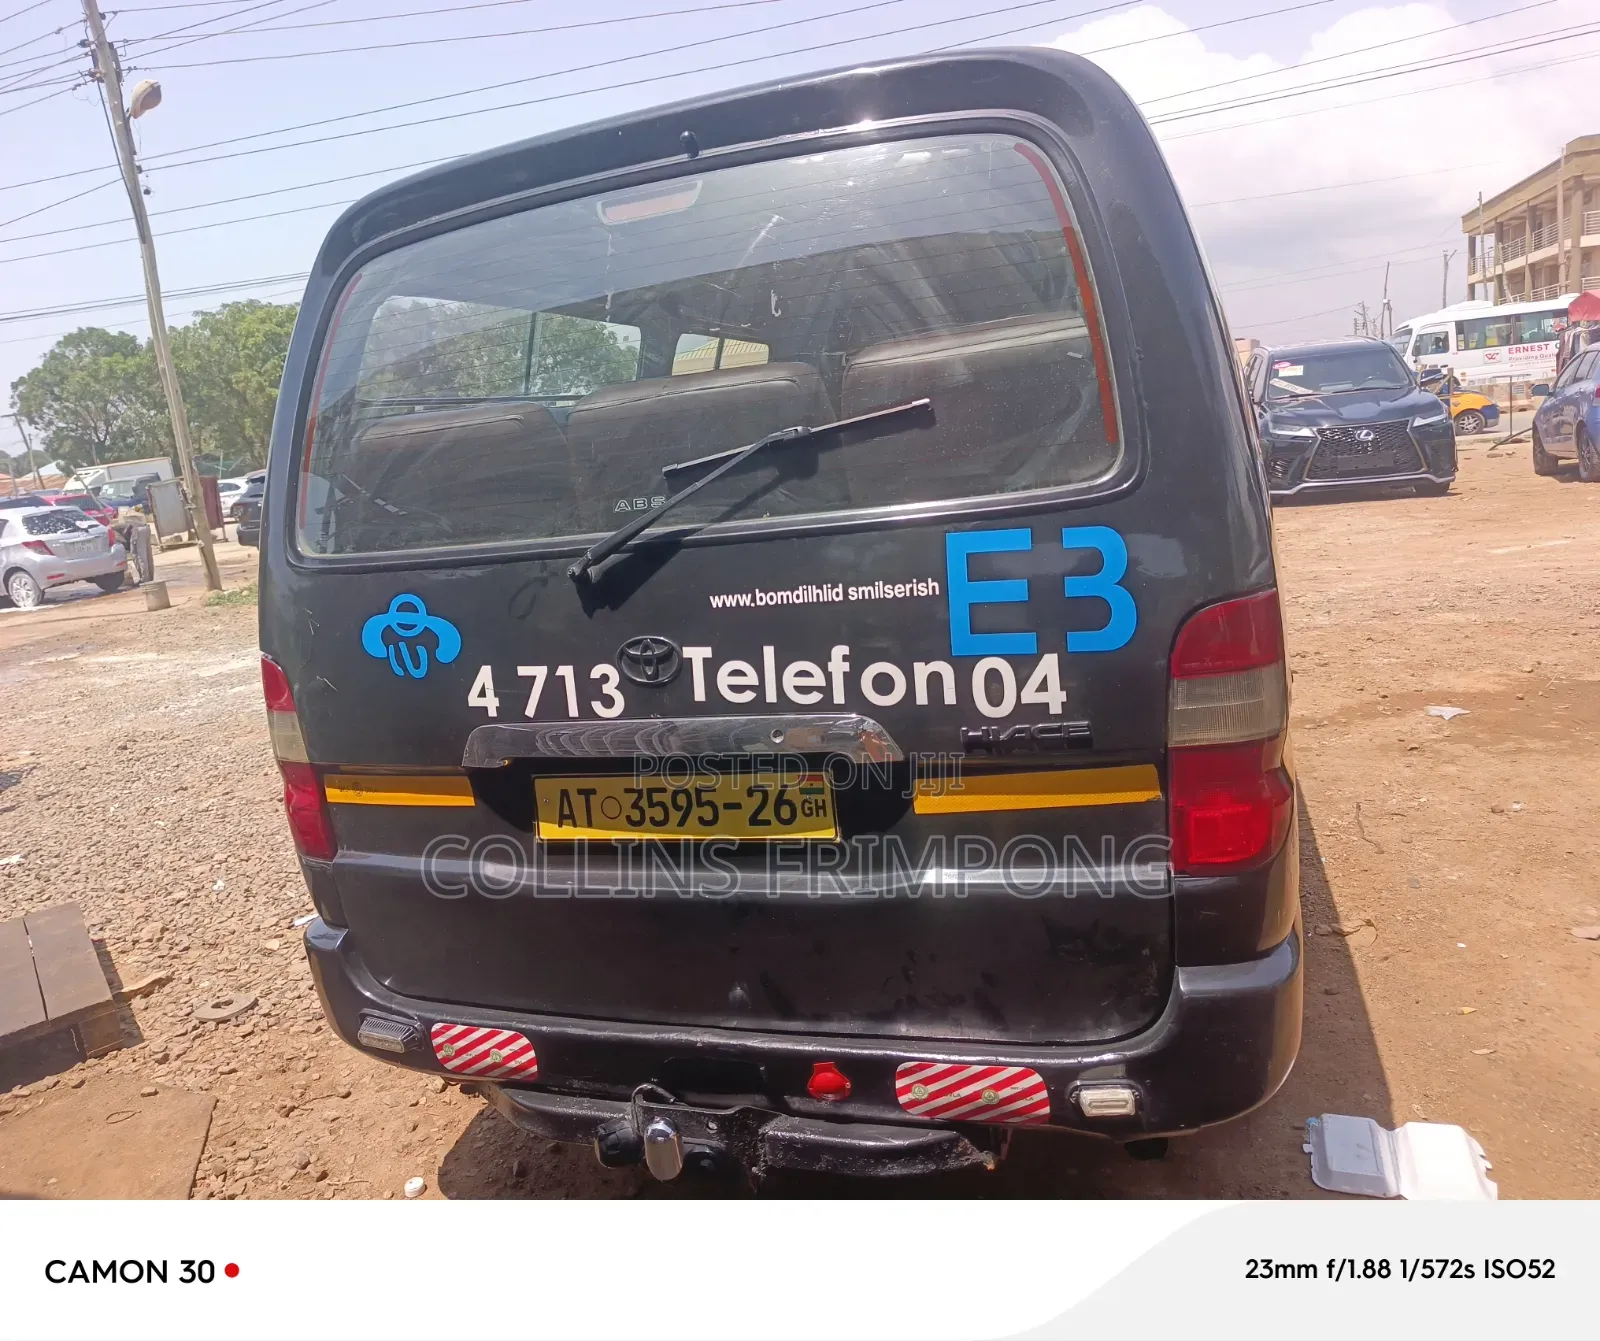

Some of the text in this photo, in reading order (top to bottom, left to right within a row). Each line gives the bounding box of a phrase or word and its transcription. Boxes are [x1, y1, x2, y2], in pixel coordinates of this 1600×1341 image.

[1508, 343, 1550, 355] ERNEST
[614, 496, 666, 512] ABS
[847, 577, 940, 601] smilserish
[682, 644, 957, 707] Telefon
[972, 653, 1067, 718] 04
[960, 720, 1092, 749] HIACE
[557, 785, 797, 829] AT 3595-26
[800, 798, 827, 819] GH
